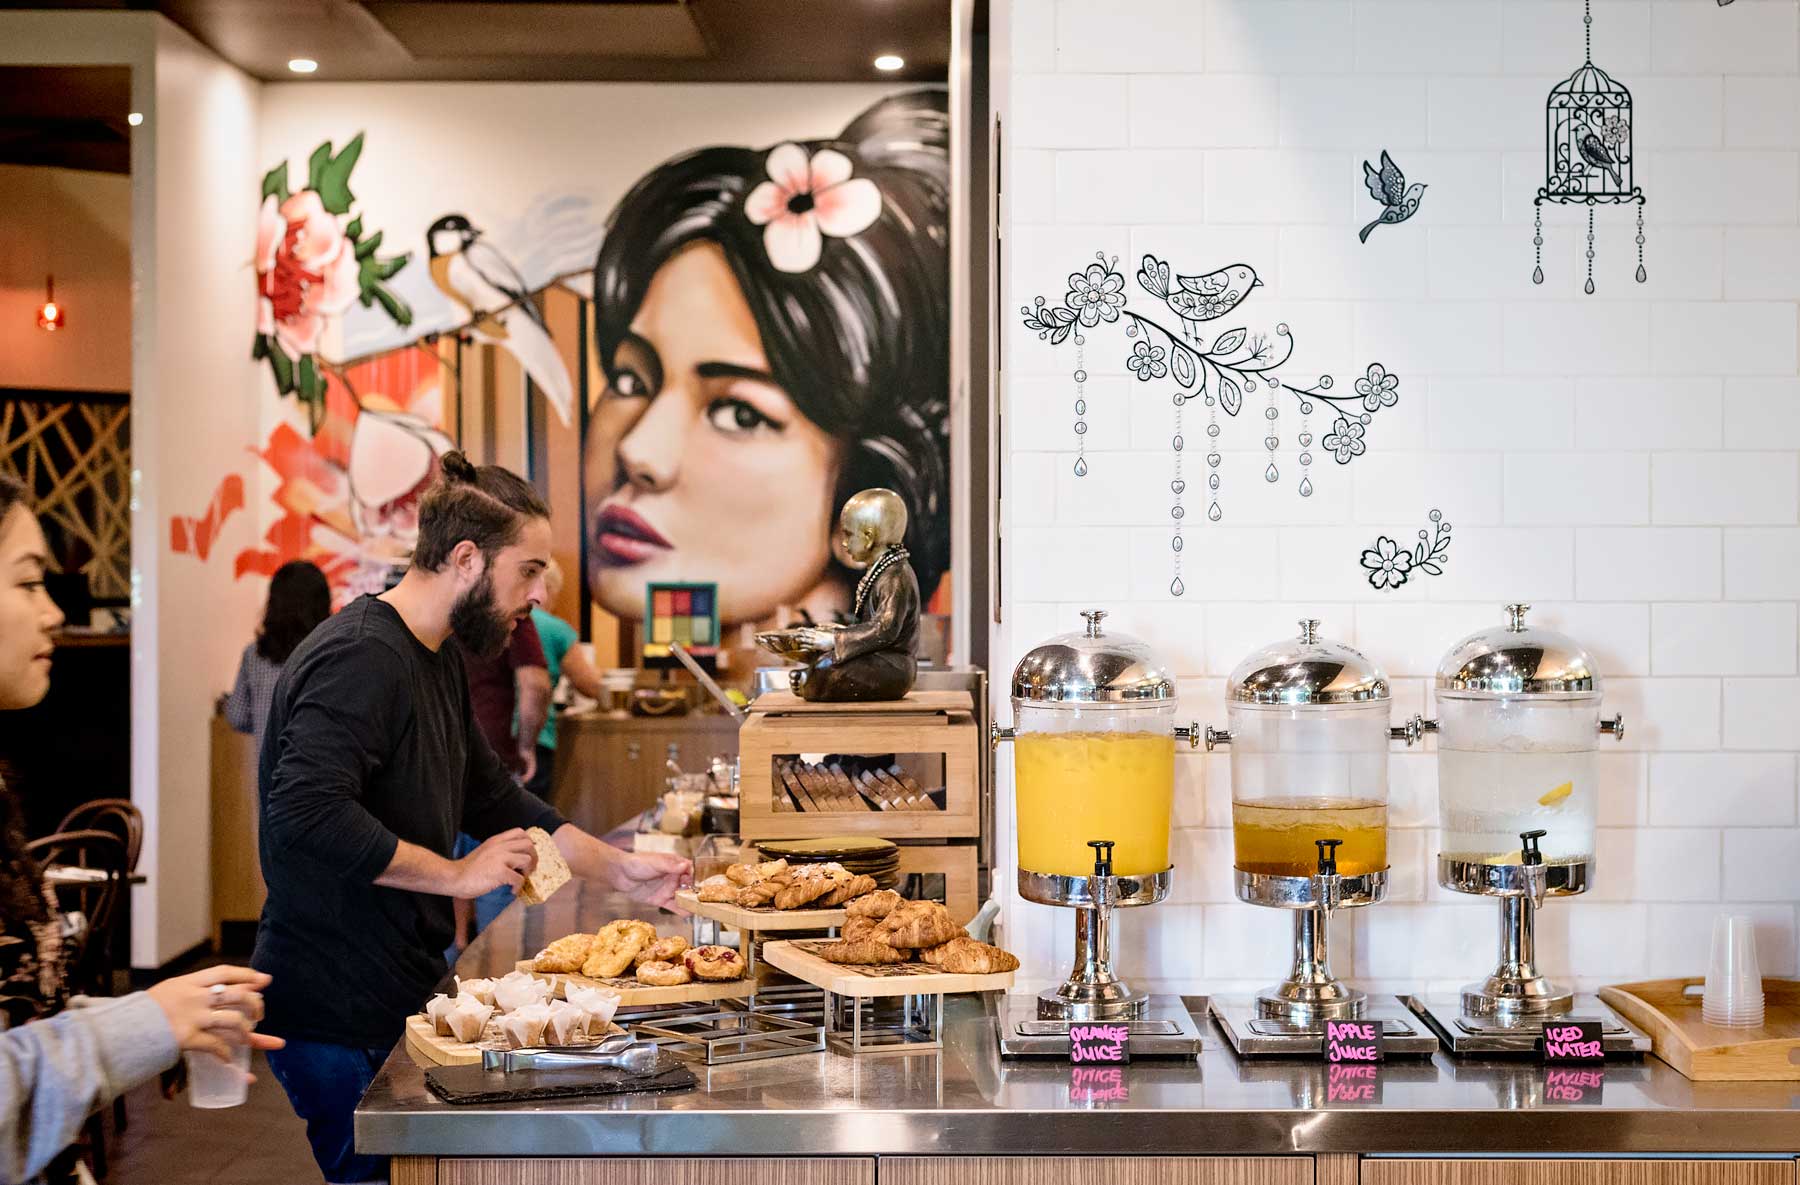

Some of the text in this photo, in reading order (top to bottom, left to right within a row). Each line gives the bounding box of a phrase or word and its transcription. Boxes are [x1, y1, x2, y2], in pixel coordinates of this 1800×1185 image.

[1069, 1024, 1129, 1044] ORANGE
[1327, 1021, 1376, 1041] APPLE
[1546, 1026, 1583, 1042] ICED
[1072, 1043, 1122, 1062] JUICE
[1329, 1041, 1377, 1061] JUICE
[1546, 1041, 1604, 1058] WATER
